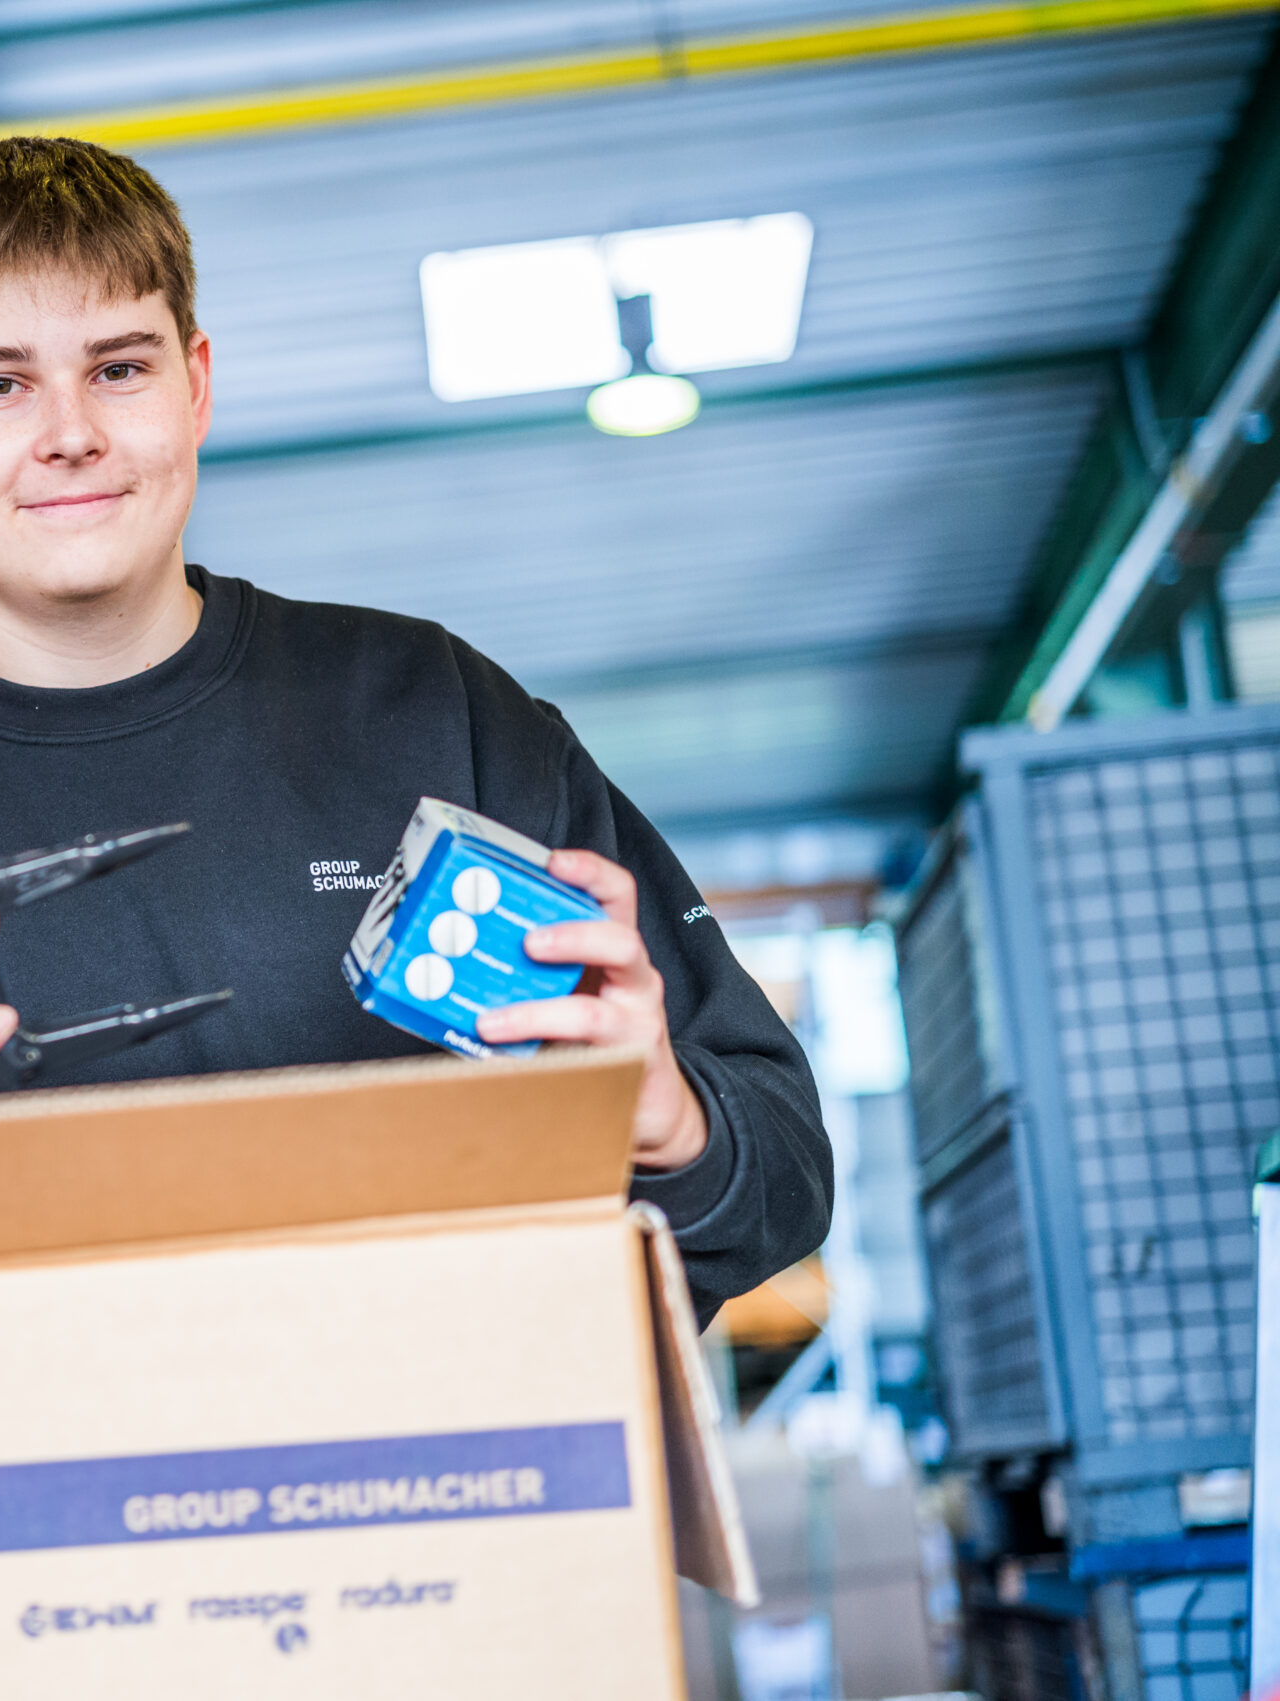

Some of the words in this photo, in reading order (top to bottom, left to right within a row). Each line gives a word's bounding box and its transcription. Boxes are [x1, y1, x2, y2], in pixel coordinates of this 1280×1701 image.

[309, 860, 360, 876] GROUP
[312, 874, 387, 892] SCHUMAC
[683, 904, 714, 924] SCH
[123, 1486, 262, 1533] GROUP
[267, 1466, 545, 1524] SCHUMACHER
